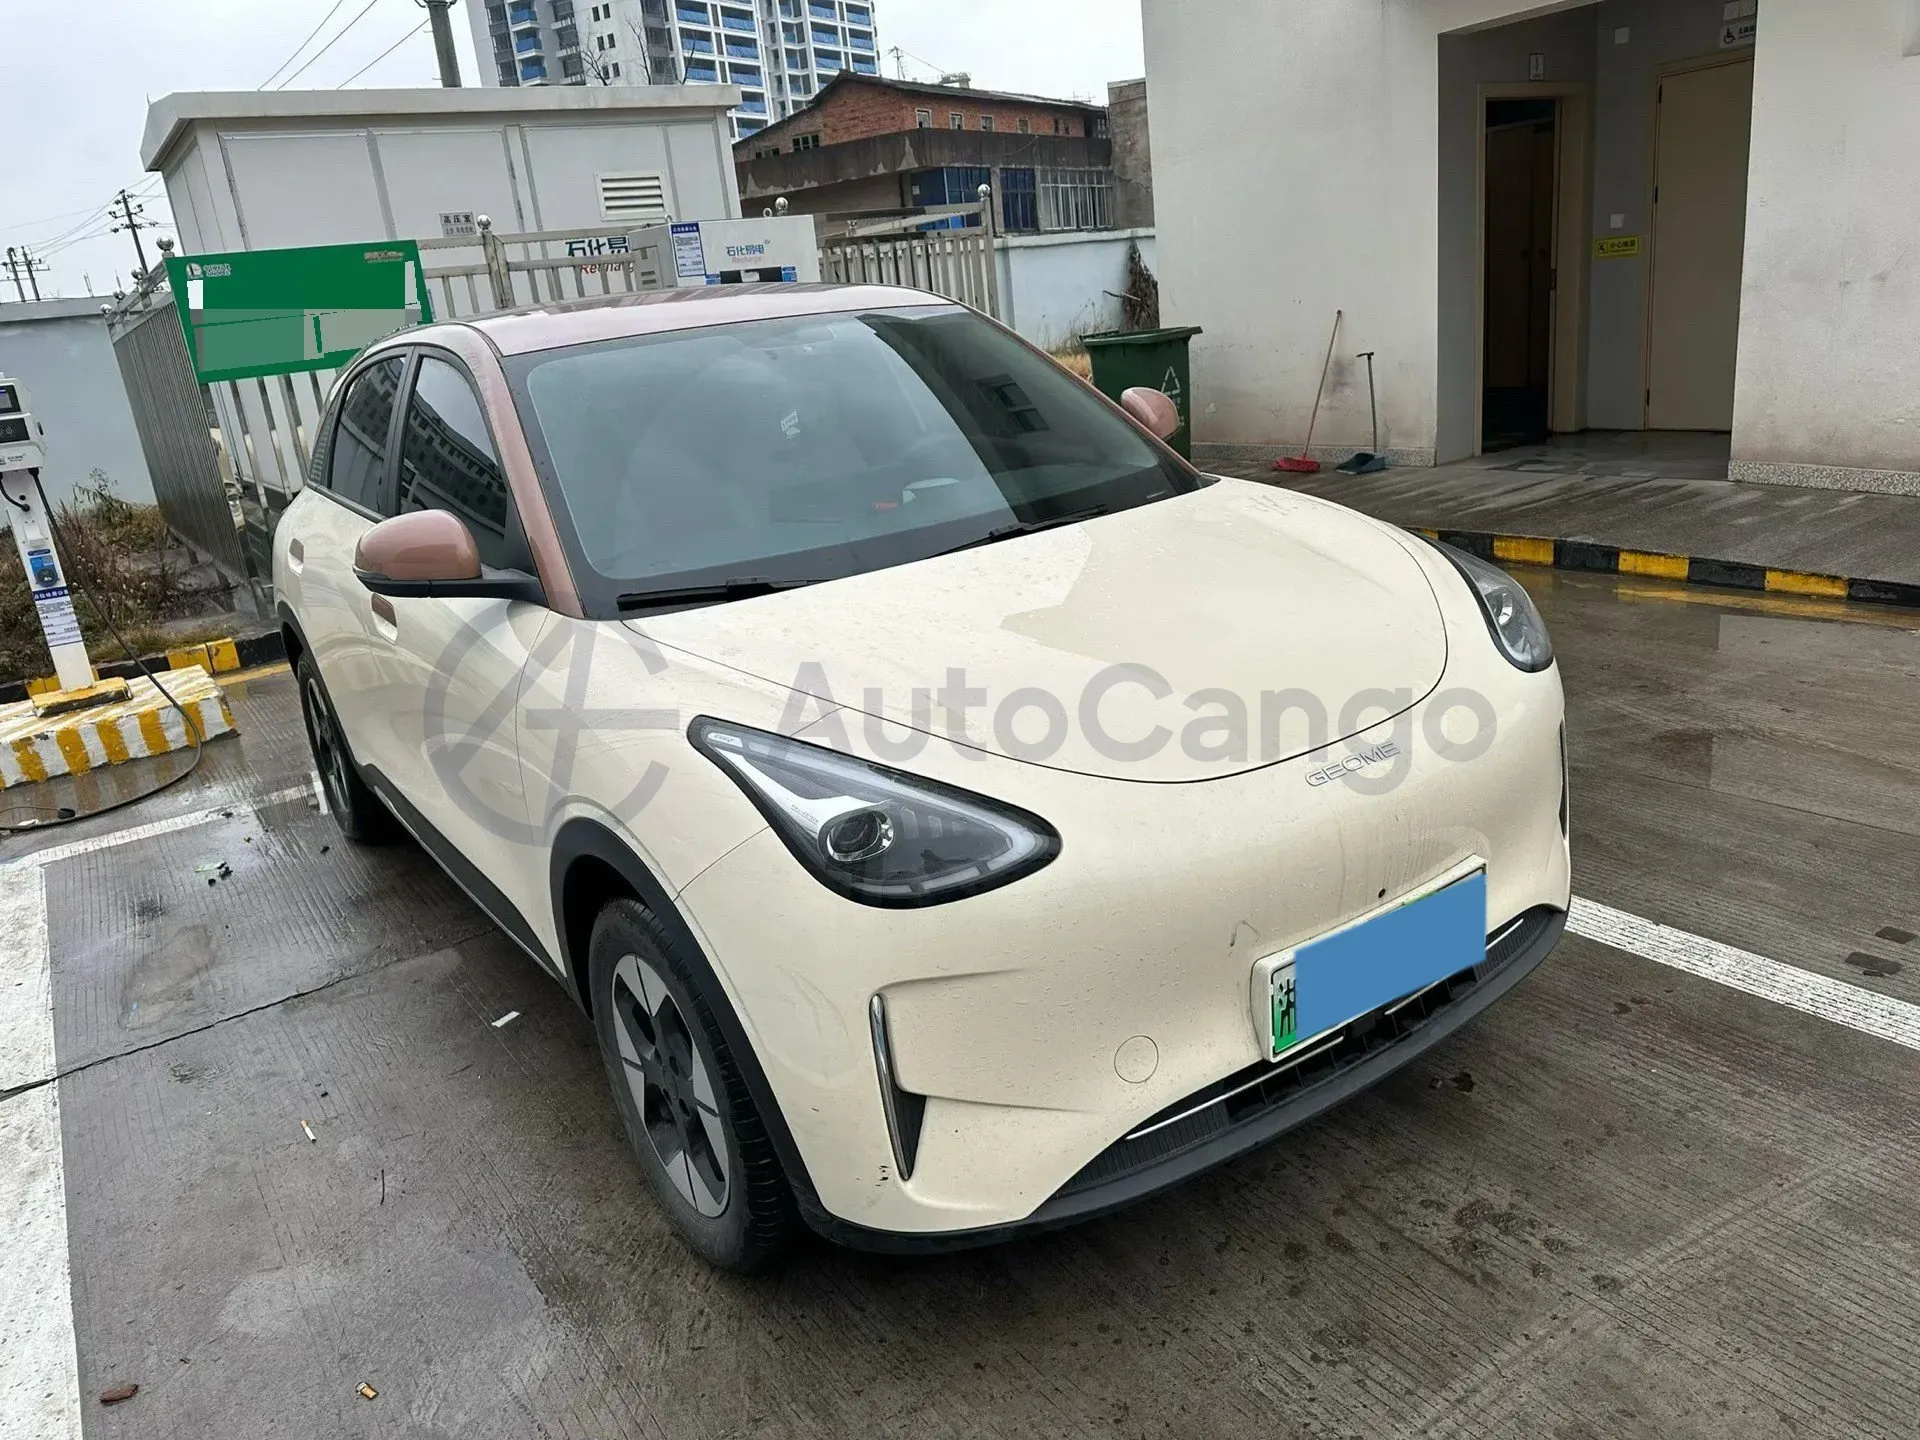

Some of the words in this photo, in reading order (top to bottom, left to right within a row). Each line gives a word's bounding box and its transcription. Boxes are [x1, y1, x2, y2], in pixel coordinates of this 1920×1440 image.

[443, 214, 472, 224] 高压室
[726, 244, 765, 257] 石化易电
[1305, 741, 1400, 788] GEOME
